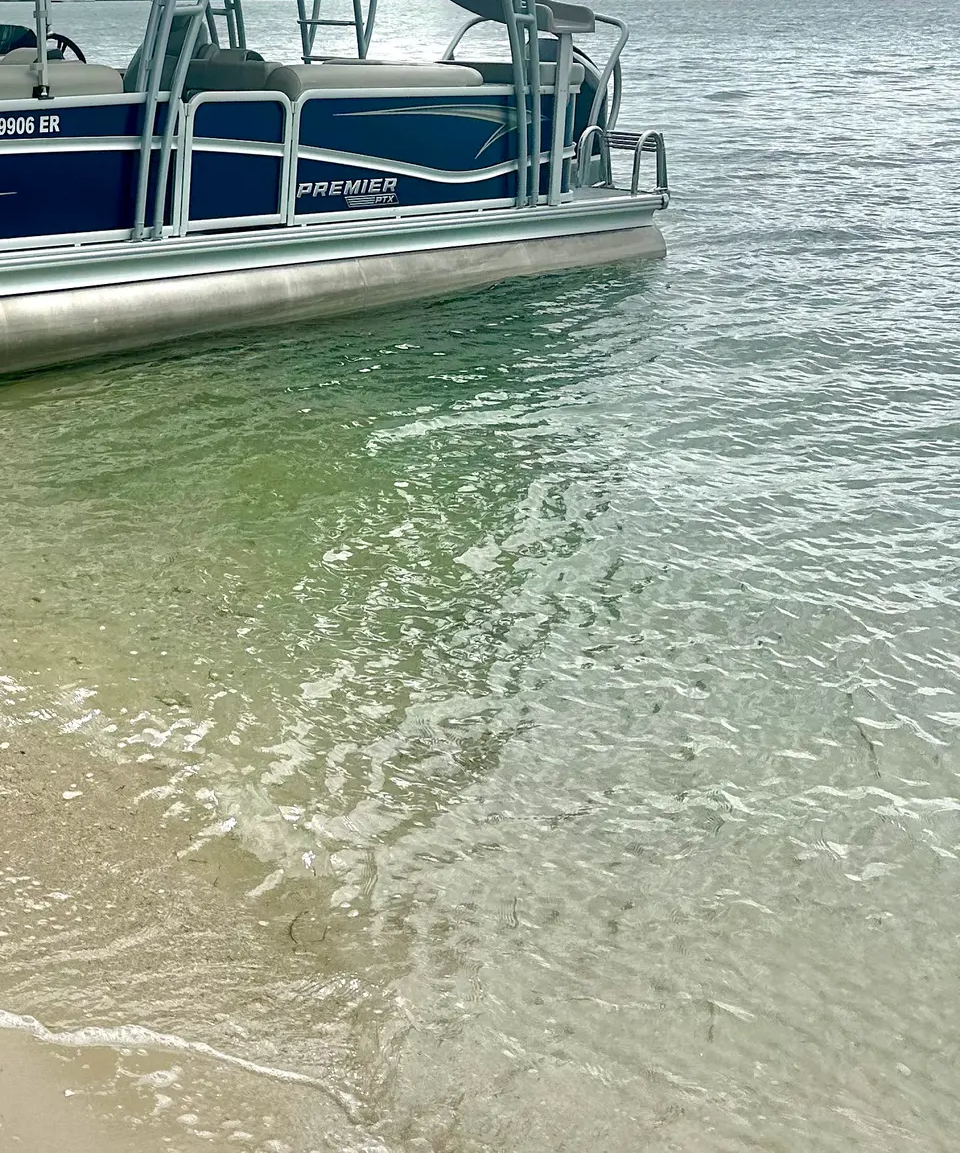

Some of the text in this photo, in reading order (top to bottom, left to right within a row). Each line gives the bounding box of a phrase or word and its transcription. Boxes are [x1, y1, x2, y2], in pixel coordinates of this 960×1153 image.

[39, 115, 60, 133] ER
[296, 178, 397, 198] PREMIER
[374, 196, 394, 204] PTX
